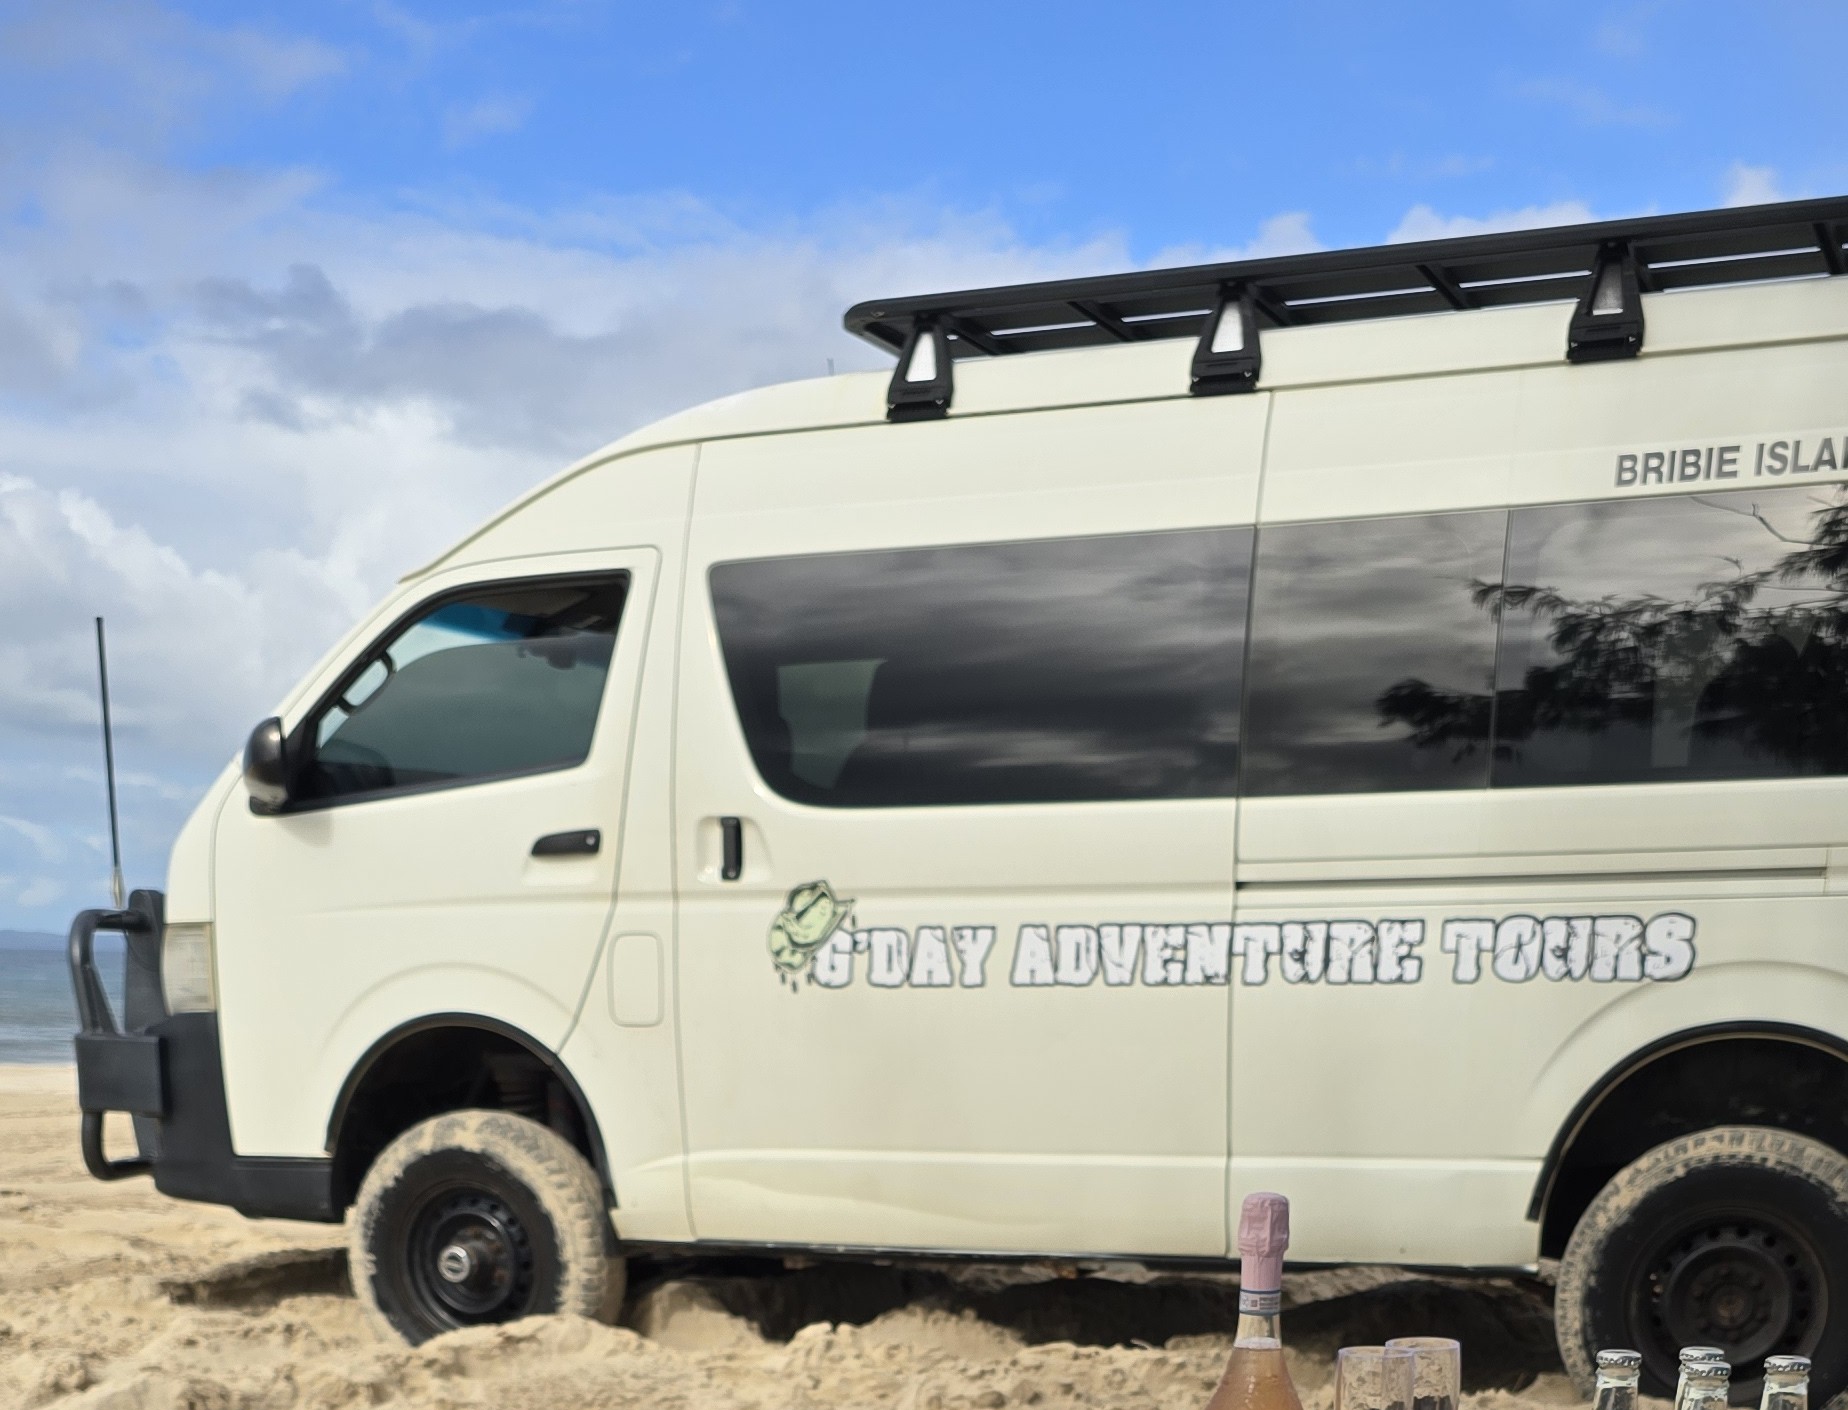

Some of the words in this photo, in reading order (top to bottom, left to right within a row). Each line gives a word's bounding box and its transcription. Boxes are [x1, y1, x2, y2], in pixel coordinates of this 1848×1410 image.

[1614, 445, 1740, 487] BRIBIE
[1754, 435, 1848, 476] ISLA
[812, 925, 997, 988] G'DAY
[1010, 918, 1426, 987] ADVENTURE
[1442, 912, 1697, 984] TOURS
